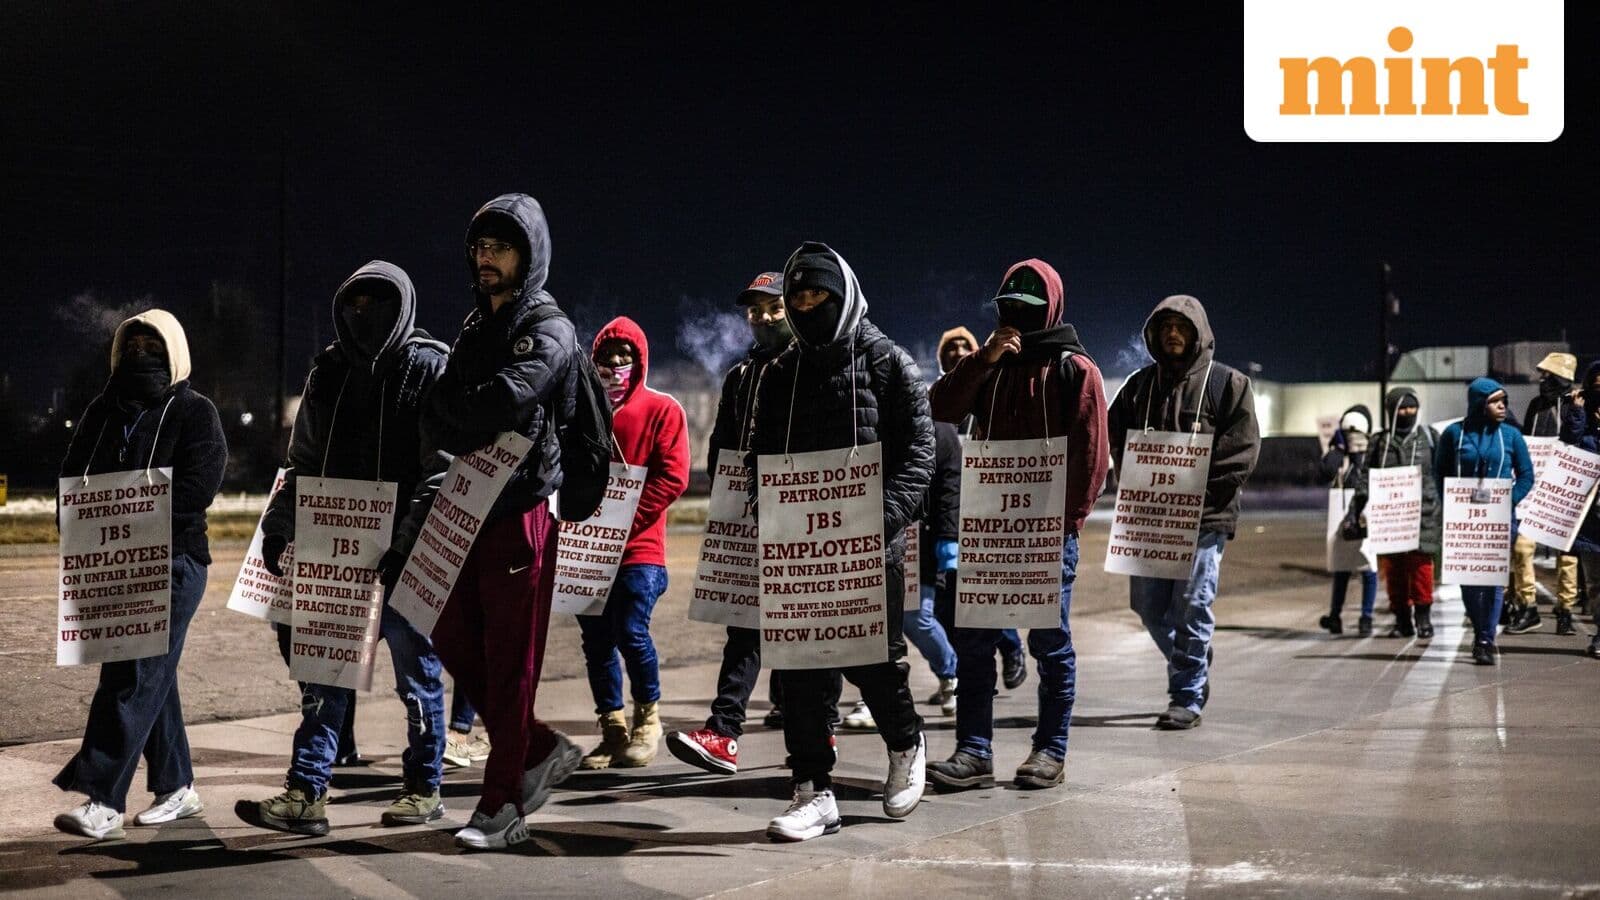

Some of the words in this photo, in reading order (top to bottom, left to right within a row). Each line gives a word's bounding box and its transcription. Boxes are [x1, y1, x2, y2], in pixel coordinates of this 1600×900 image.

[492, 447, 519, 468] NOT
[1128, 443, 1165, 453] PLEASE
[1168, 445, 1183, 455] DO
[1186, 447, 1209, 456] NOT
[965, 457, 1014, 468] PLEASE
[1017, 456, 1037, 468] DO
[1040, 454, 1064, 466] NOT
[1136, 455, 1196, 468] PATRONIZE
[1554, 450, 1581, 464] PLEASE
[1583, 460, 1593, 468] DO
[762, 473, 819, 487] PLEASE
[823, 468, 846, 482] DO
[850, 463, 879, 479] NOT
[979, 471, 1052, 483] PATRONIZE
[1150, 473, 1175, 487] JBS
[1564, 476, 1583, 487] JBS
[451, 474, 471, 496] JBS
[617, 478, 641, 489] NOT
[63, 490, 112, 505] PLEASE
[115, 487, 136, 499] DO
[140, 484, 168, 496] NOT
[779, 483, 866, 503] PATRONIZE
[1120, 489, 1201, 506] EMPLOYEES
[78, 501, 154, 519] PATRONIZE
[299, 495, 345, 508] PLEASE
[350, 499, 366, 512] DO
[371, 501, 393, 514] NOT
[1001, 494, 1031, 512] JBS
[1118, 504, 1132, 512] ON
[1134, 506, 1167, 516] UNFAIR
[1169, 508, 1200, 518] LABOR
[313, 513, 381, 530] PATRONIZE
[434, 492, 480, 535] EMPLOYEES
[1468, 509, 1487, 519] JBS
[807, 511, 842, 534] JBS
[962, 517, 1061, 533] EMPLOYEES
[1116, 516, 1164, 527] PRACTICE
[1165, 520, 1198, 530] STRIKE
[1446, 522, 1509, 532] EMPLOYEES
[101, 525, 131, 545] JBS
[1546, 526, 1567, 537] LOCAL
[332, 538, 360, 557] JBS
[448, 530, 470, 552] LABOR
[559, 537, 589, 550] NFAIR
[590, 542, 622, 553] LABOR
[704, 539, 721, 549] ON
[723, 541, 757, 553] UNFAIR
[763, 534, 881, 560] EMPLOYEES
[961, 538, 979, 547] ON
[983, 538, 1025, 548] UNFAIR
[1028, 537, 1061, 547] LABOR
[63, 546, 168, 570] EMPLOYEES
[584, 554, 619, 565] STRIKE
[702, 552, 753, 567] PRACTICE
[961, 553, 1022, 563] PRACTICE
[1025, 552, 1060, 563] STRIKE
[1111, 546, 1142, 557] UFCW
[1143, 550, 1178, 560] LOCAL
[63, 575, 80, 585] ON
[85, 569, 127, 583] UNFAIR
[130, 565, 168, 579] LABOR
[763, 566, 784, 577] ON
[788, 563, 838, 576] UNFAIR
[842, 557, 882, 573] LABOR
[63, 585, 124, 600] PRACTICE
[127, 580, 168, 593] STRIKE
[239, 578, 253, 587] CON
[558, 584, 594, 596] LOCAL
[596, 587, 608, 597] #7
[764, 580, 835, 594] PRACTICE
[839, 575, 882, 591] STRIKE
[241, 591, 269, 604] UFCW
[296, 584, 313, 595] ON
[315, 585, 352, 599] UNFAIR
[695, 588, 729, 602] UFCW
[731, 594, 760, 606] LOCA
[959, 592, 999, 604] UFCW
[1002, 594, 1044, 605] LOCAL
[296, 600, 348, 616] PRACTICE
[782, 603, 795, 611] WE
[797, 602, 819, 610] HAVE
[836, 598, 869, 607] DISPUTE
[791, 611, 808, 619] ANY
[810, 610, 839, 618] OTHER
[841, 605, 881, 616] EMPLOYER
[61, 627, 102, 641] UFCW
[106, 623, 150, 638] LOCAL
[154, 620, 167, 631] #7
[764, 629, 810, 642] UFCW
[815, 624, 866, 640] LOCAL
[870, 622, 884, 636] #7
[294, 643, 326, 658] UFCW
[328, 647, 360, 663] LOCA
